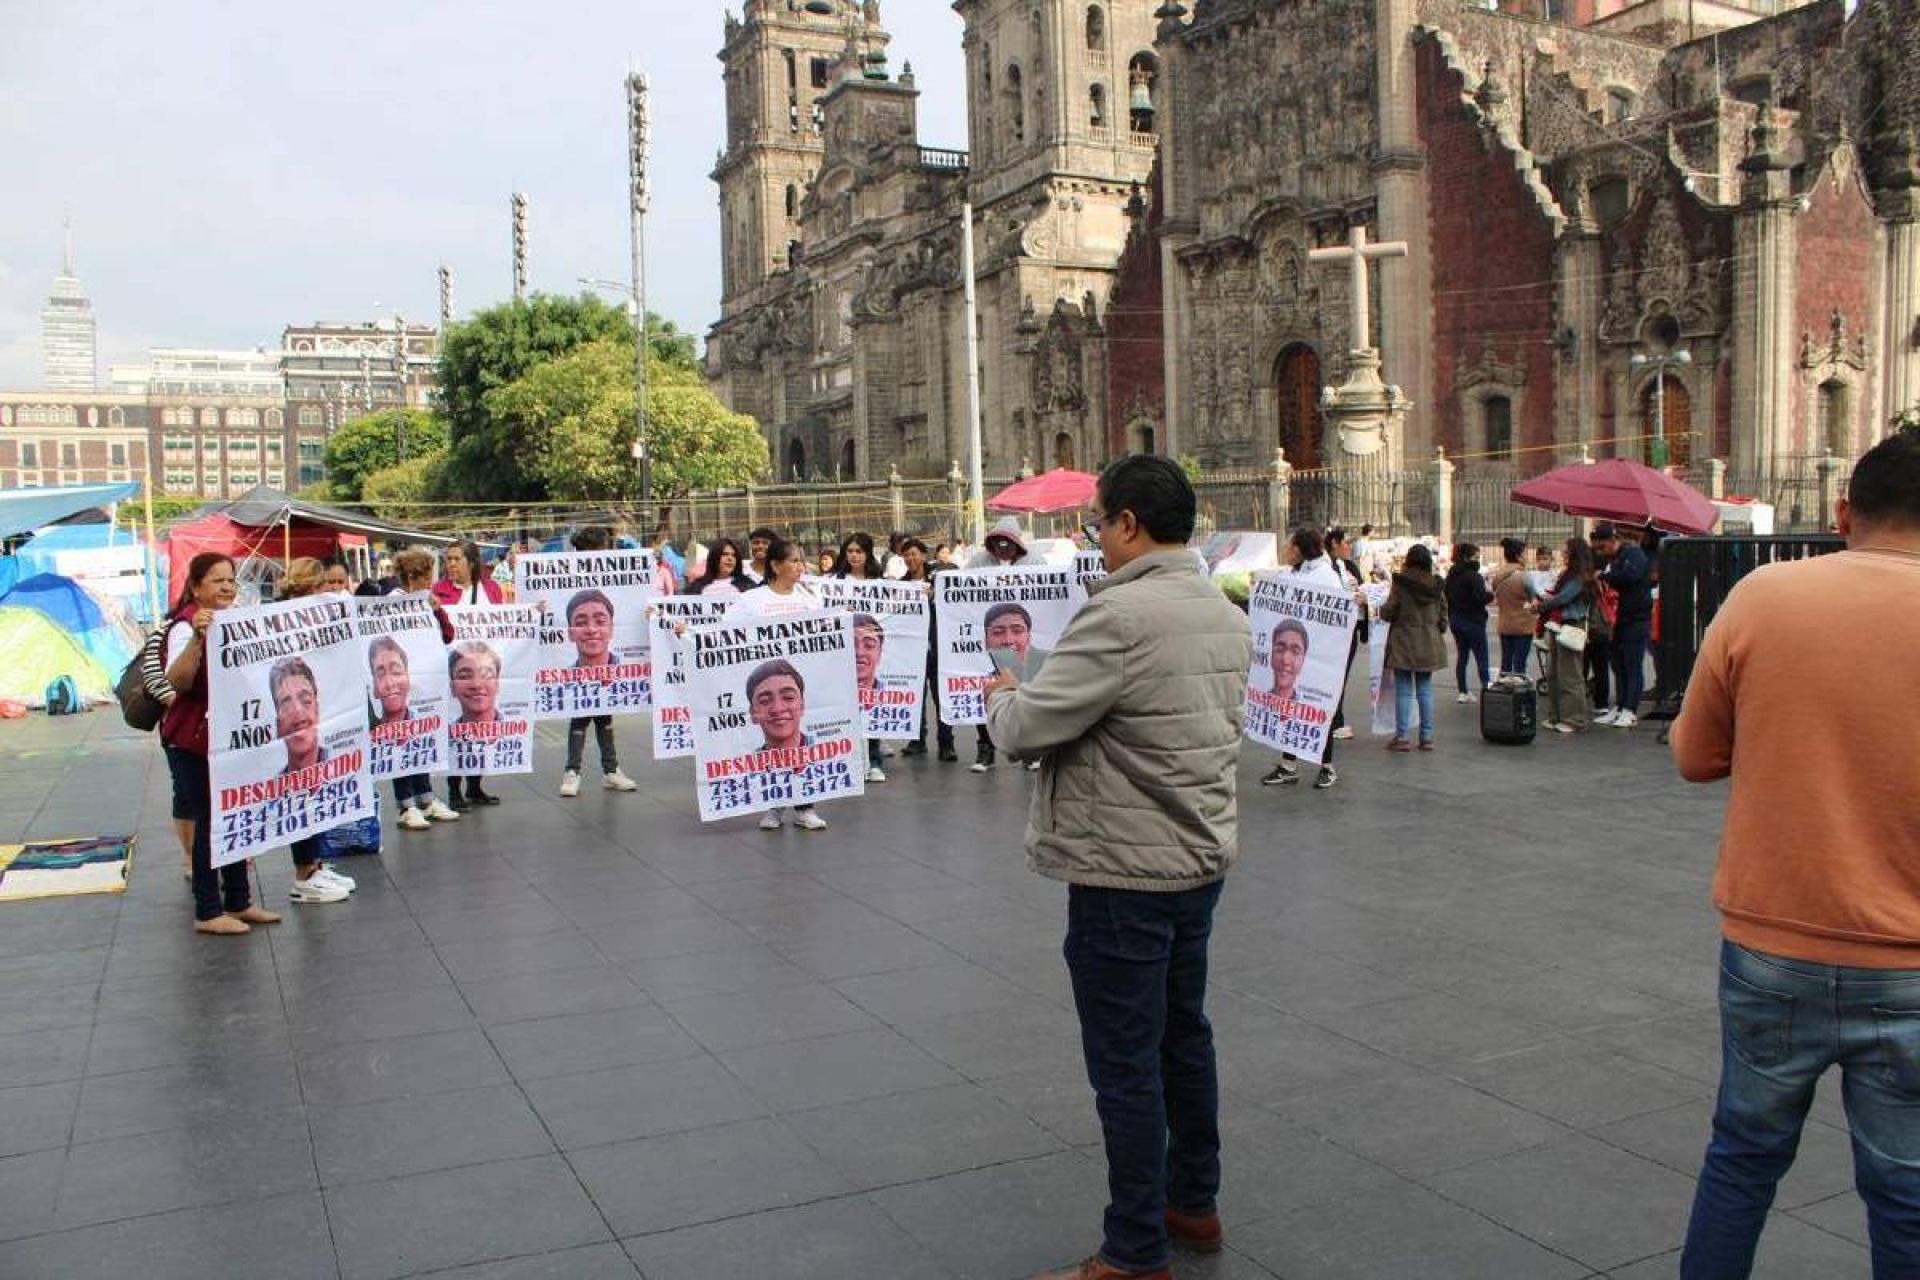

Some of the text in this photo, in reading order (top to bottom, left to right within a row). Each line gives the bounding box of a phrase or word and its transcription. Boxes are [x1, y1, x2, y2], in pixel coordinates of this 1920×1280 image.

[526, 556, 651, 577] JUAN MANUEL
[1076, 557, 1105, 573] JUA
[525, 573, 651, 591] CONTRERAS BAHENA
[943, 575, 988, 588] JUAN
[996, 573, 1069, 586] MANUEL
[853, 586, 922, 602] MANUEL
[943, 586, 1070, 604] CONTRERAS BAHENA
[1255, 581, 1288, 597] JUAN
[1291, 588, 1353, 614] MANUEL
[657, 602, 703, 617] JUAN
[875, 601, 923, 615] BAHENA
[1307, 605, 1349, 629] BAHENA
[220, 618, 259, 647] JUAN
[264, 601, 351, 636] MANUEL
[458, 609, 539, 626] MANUEL
[540, 612, 555, 627] 17
[540, 629, 564, 645] ÑOS
[695, 618, 845, 652] JUAN MANUEL
[959, 623, 972, 637] 17
[220, 621, 354, 669] CONTRERAS BAHENA
[695, 633, 846, 670] CONTRERAS BAHENA
[951, 638, 983, 653] AÑOS
[607, 680, 651, 696] 4816
[573, 696, 600, 710] 101
[607, 693, 652, 708] 5474
[718, 692, 734, 710] 17
[858, 689, 916, 706] RECIDO
[240, 698, 262, 722] 17
[869, 706, 911, 721] 4816
[708, 713, 747, 732] AÑOS
[868, 720, 912, 733] 5474
[1284, 720, 1322, 740] 4816
[229, 722, 272, 751] AÑOS
[1280, 735, 1321, 753] 5474
[400, 749, 438, 770] 5474
[457, 754, 486, 769] 101
[706, 738, 853, 779] DESAPARECIDO
[220, 749, 364, 811] DESAPARECIDO
[709, 761, 848, 798] 734 117 4816
[710, 773, 852, 811] 734 101 5474
[222, 775, 360, 834] 734 117 4816
[221, 794, 363, 853] 734 101 5474
